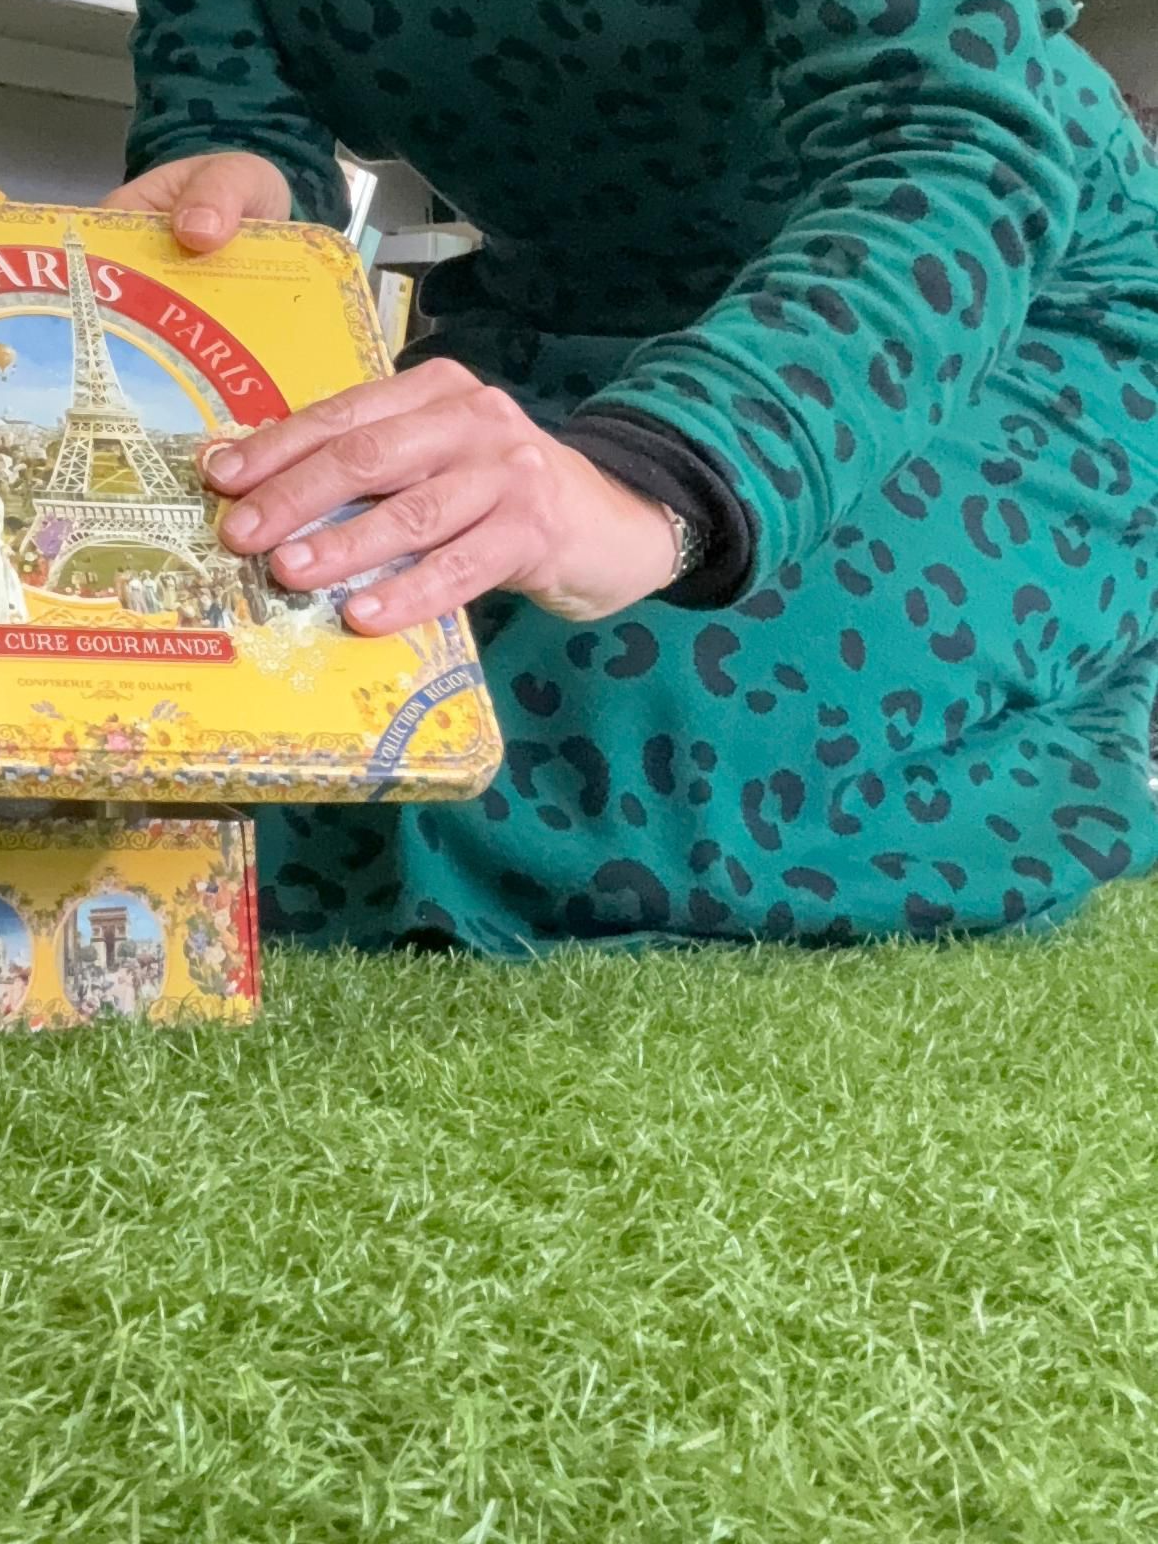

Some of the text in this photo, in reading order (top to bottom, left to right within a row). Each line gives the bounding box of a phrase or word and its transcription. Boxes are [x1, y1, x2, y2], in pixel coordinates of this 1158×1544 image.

[156, 302, 264, 397] PARIS
[4, 632, 69, 652] CURE
[76, 635, 223, 656] GOURMANDE
[17, 677, 93, 689] CONFISERIE
[119, 680, 135, 691] DE
[379, 697, 427, 768] COLLECTION
